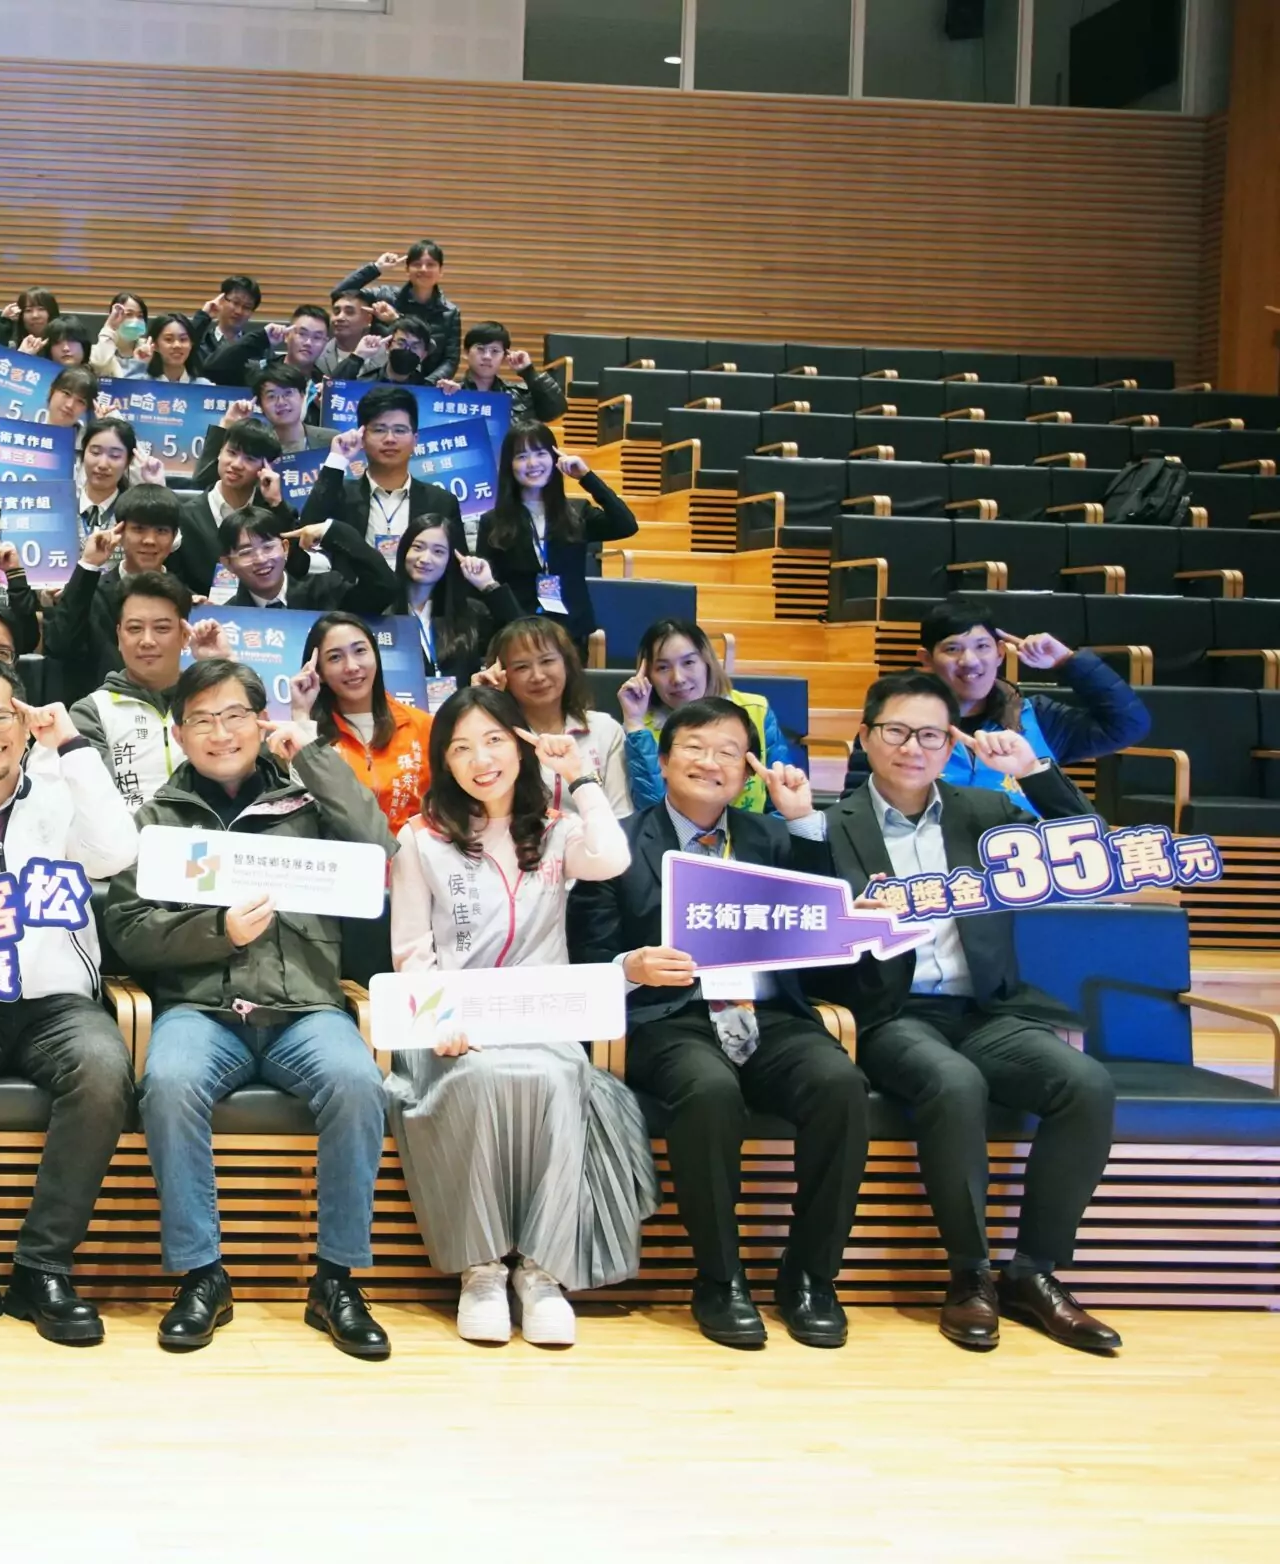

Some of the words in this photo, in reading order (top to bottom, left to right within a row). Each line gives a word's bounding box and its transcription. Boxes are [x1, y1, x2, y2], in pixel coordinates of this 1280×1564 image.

[433, 401, 492, 417] 創意點子組
[0, 431, 54, 450] 術實作組
[413, 435, 468, 457] 術實作組
[474, 481, 493, 499] 元
[48, 550, 68, 568] 元
[234, 853, 339, 873] 智慧城鄉發展委員會
[872, 820, 1216, 917] 總獎金35萬元
[448, 873, 472, 953] 侯佳齡
[685, 902, 828, 931] 技術實作組
